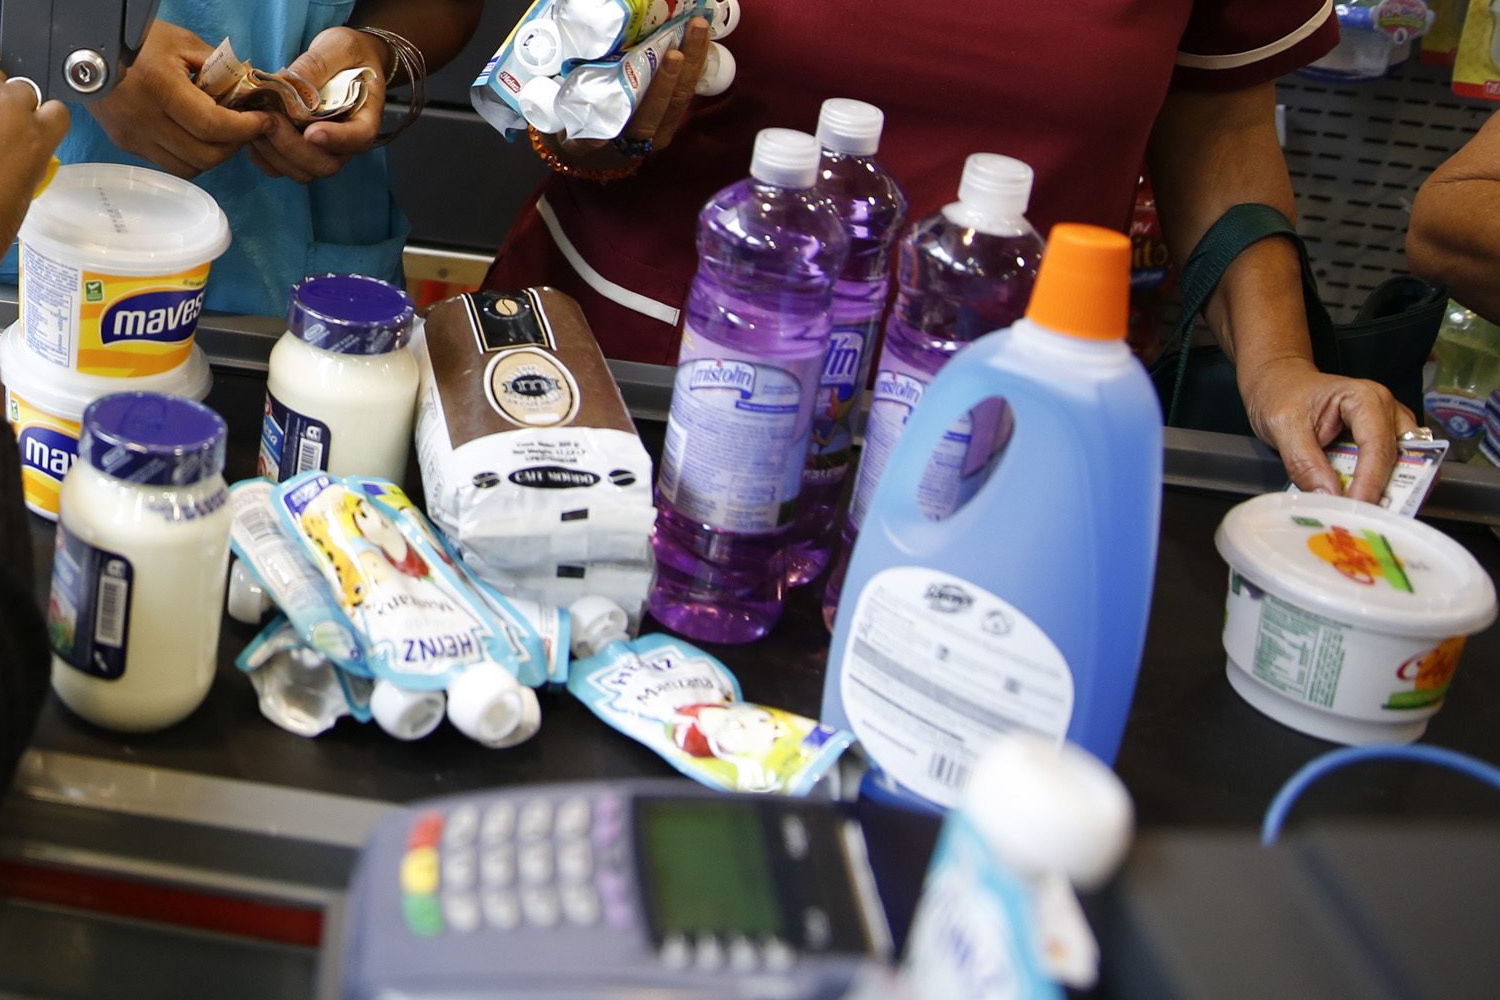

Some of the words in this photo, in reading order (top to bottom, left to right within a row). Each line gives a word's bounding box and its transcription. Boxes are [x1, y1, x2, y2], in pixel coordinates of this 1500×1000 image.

[499, 72, 521, 93] Heinz
[113, 292, 205, 337] maves
[403, 633, 472, 663] HEINZ
